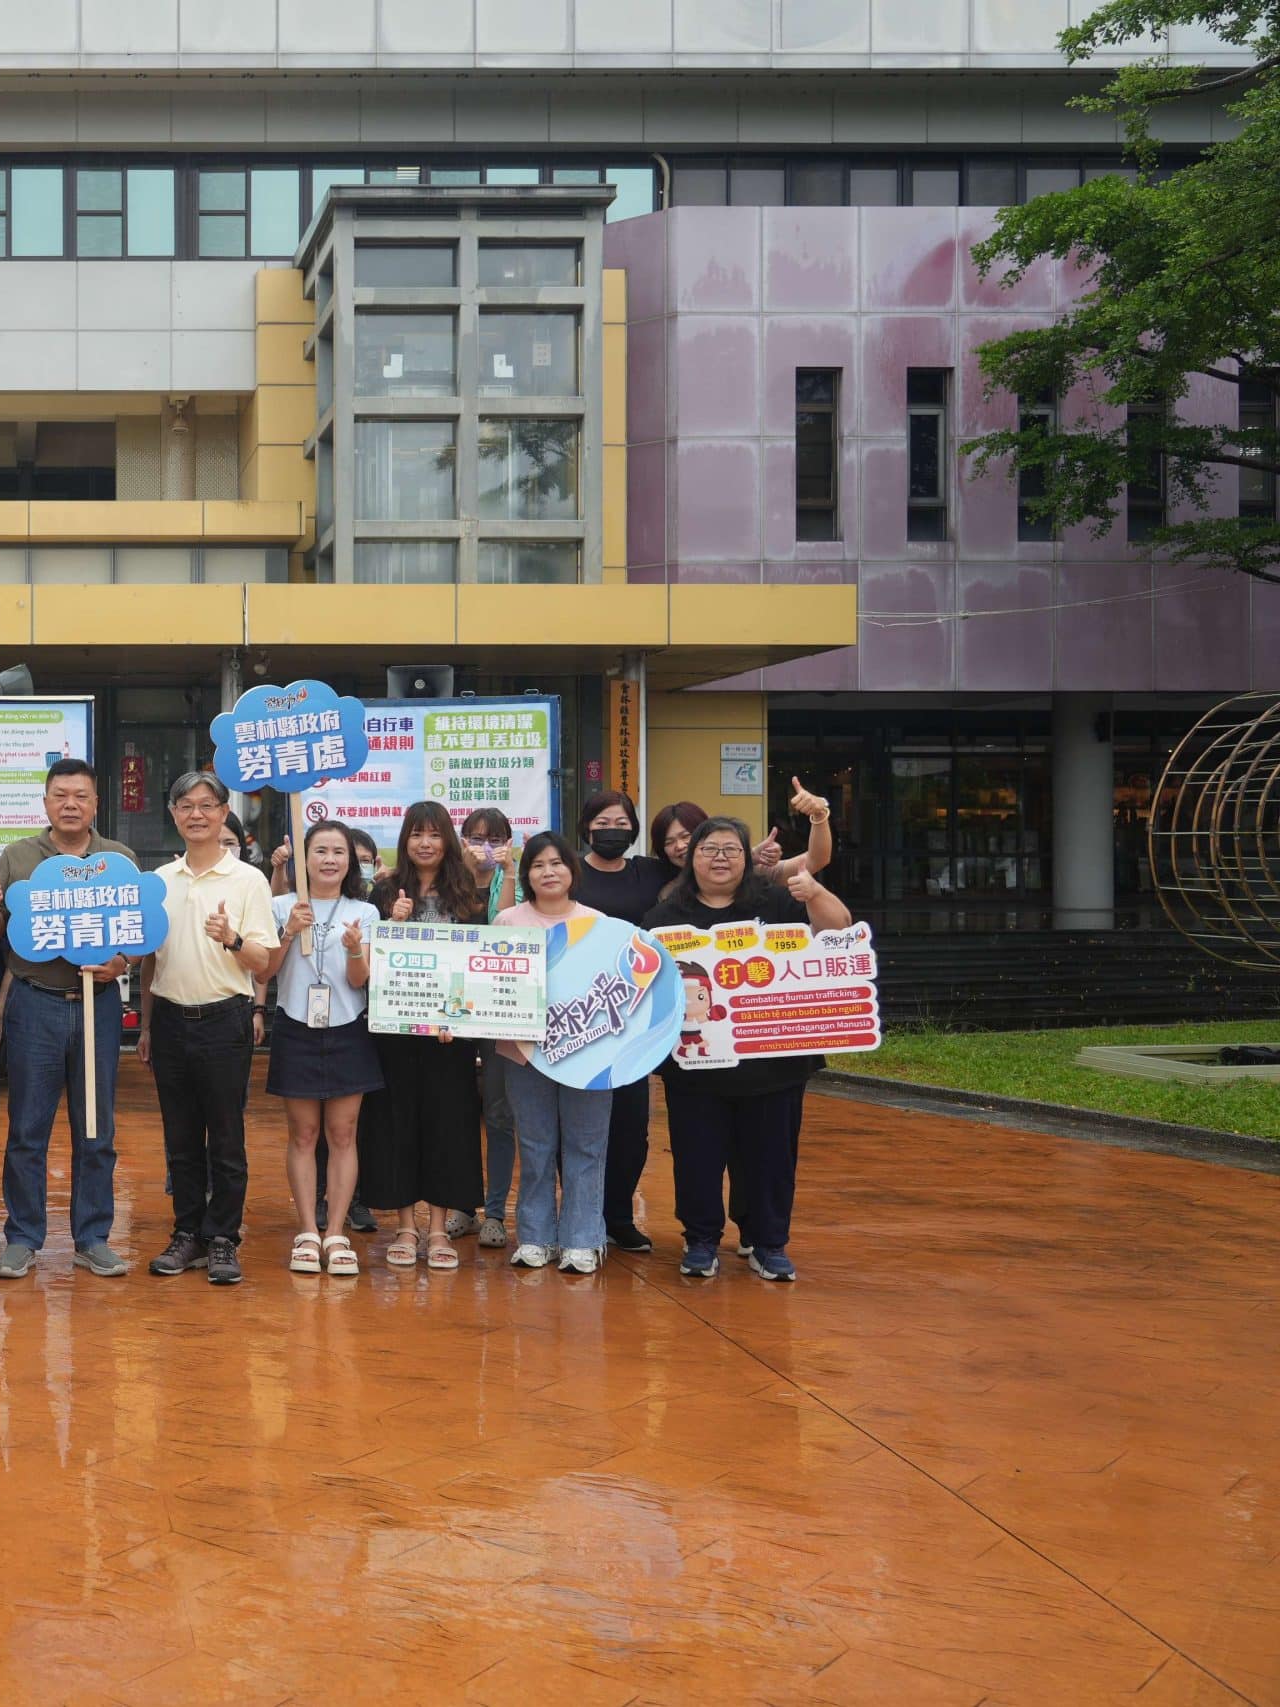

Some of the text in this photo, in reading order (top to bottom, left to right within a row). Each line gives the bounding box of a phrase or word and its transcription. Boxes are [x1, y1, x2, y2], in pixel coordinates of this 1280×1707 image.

[234, 710, 341, 744] 雲林縣政府
[363, 717, 414, 732] 自行車
[434, 713, 534, 731] 維持環境清潔
[427, 732, 542, 750] 請不要亂丟垃圾
[237, 735, 347, 782] 勞青處
[449, 757, 535, 769] 請做好垃圾分類
[449, 777, 510, 789] 垃圾請交給
[449, 789, 510, 801] 垃圾車清運
[29, 884, 139, 912] 雲林縣政府
[30, 909, 145, 951] 勞青處
[376, 925, 481, 943] 微型電動二輪車
[727, 939, 744, 949] 110
[775, 941, 797, 950] 1955
[719, 953, 872, 985] 打擊 人口販運
[739, 994, 785, 1005] Combating
[785, 991, 814, 1002] human
[735, 1019, 871, 1035] Memerangi Perdagangan Manusia
[547, 1023, 608, 1063] It's Our Time
